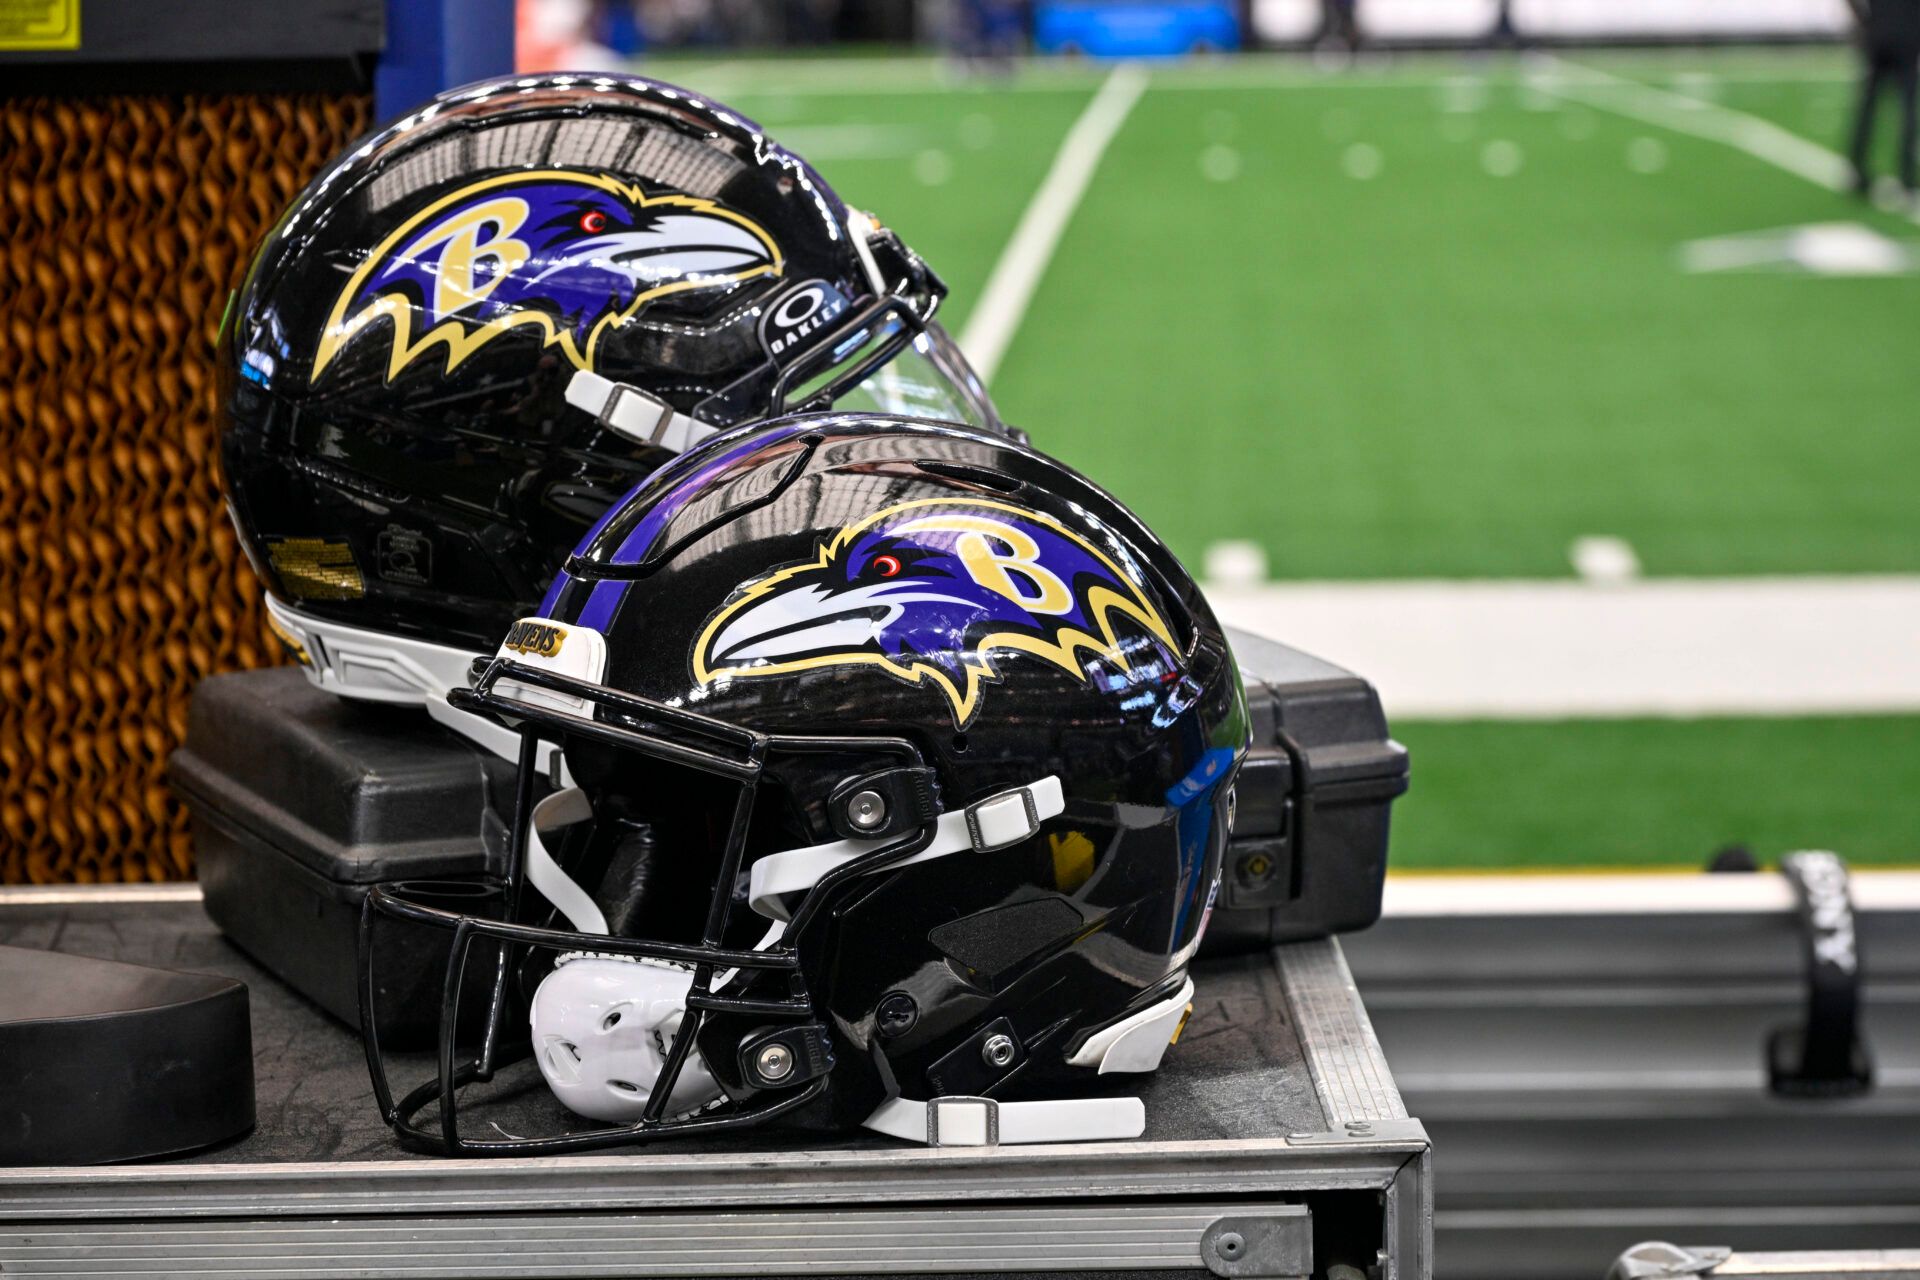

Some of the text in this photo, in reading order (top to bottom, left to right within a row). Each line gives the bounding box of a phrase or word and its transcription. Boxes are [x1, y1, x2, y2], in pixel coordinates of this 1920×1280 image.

[770, 299, 842, 354] OAKLEY
[505, 621, 567, 657] RAVENS
[967, 813, 981, 849] SPORTSTAR
